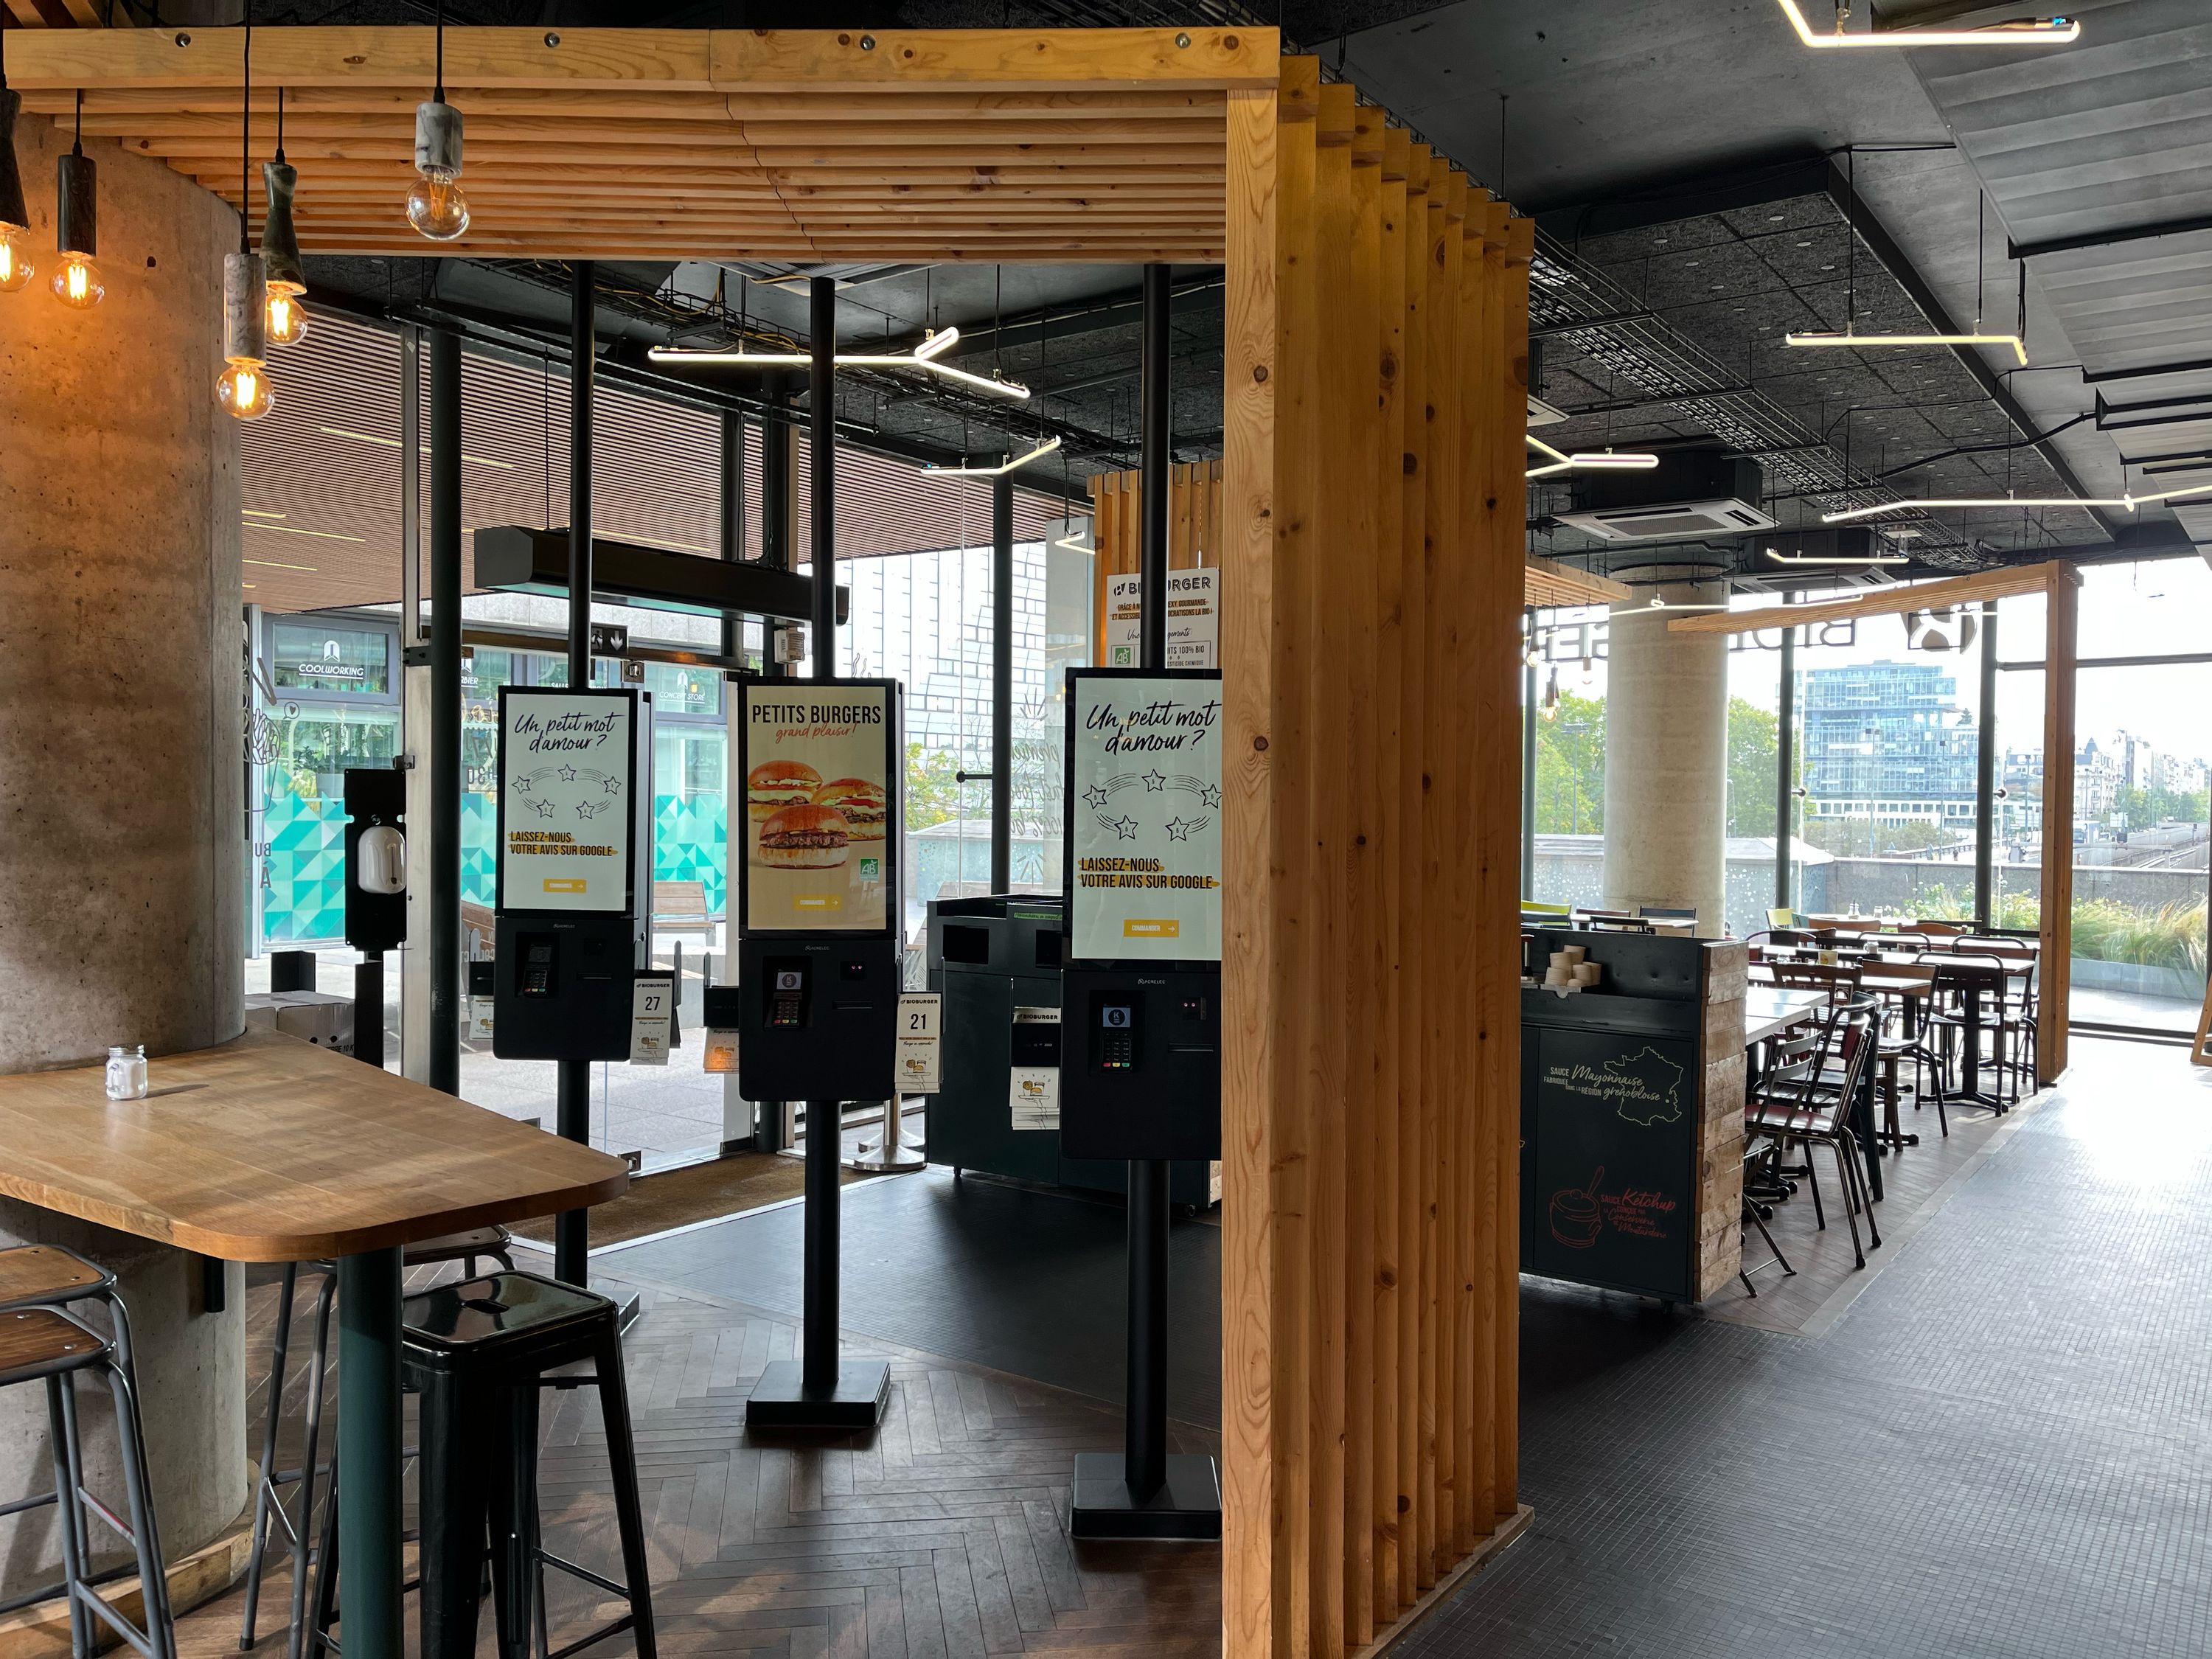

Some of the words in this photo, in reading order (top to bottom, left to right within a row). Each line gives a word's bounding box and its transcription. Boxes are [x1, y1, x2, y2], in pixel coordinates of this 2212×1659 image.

[1128, 577, 1211, 595] BIRGER
[1119, 612, 1141, 620] ACCESSIBL
[1168, 608, 1194, 617] OCRATISONS
[1179, 646, 1194, 654] 100%
[1195, 645, 1204, 653] BIO
[299, 664, 364, 676] COOLWORKING
[461, 676, 478, 685] RBIER
[687, 693, 705, 701] STORE
[752, 705, 805, 723] PETITS
[811, 705, 881, 724] BURGERS
[1086, 703, 1119, 730] Un
[1127, 700, 1186, 732] petit
[1175, 700, 1222, 726] mot
[515, 714, 540, 734] Un
[546, 712, 592, 736] petit
[585, 712, 625, 732] mot
[775, 721, 812, 744] grand
[1105, 725, 1188, 756] d'amour
[529, 729, 594, 754] d'amour
[510, 831, 571, 842] LAISSEZ-NOUS
[510, 844, 537, 855] VOTRE
[540, 844, 558, 855] AVIS
[560, 845, 577, 855] SUR
[580, 846, 613, 856] GOOGLE
[1081, 858, 1159, 872] LAISSEZ-NOUS
[1081, 874, 1116, 887] VOTRE
[1119, 874, 1143, 888] AVIS
[1146, 875, 1166, 888] SUR
[1171, 875, 1213, 889] GOOGLE
[645, 996, 660, 1011] 27
[911, 1013, 926, 1029] 21
[1550, 1066, 1569, 1077] SAUCE
[1571, 1064, 1643, 1087] Mayonnaise
[1581, 1085, 1601, 1096] RÉGION
[1603, 1085, 1660, 1101] grenobloise
[1600, 1194, 1621, 1205] SAUCE
[1622, 1188, 1675, 1214] Ketchup
